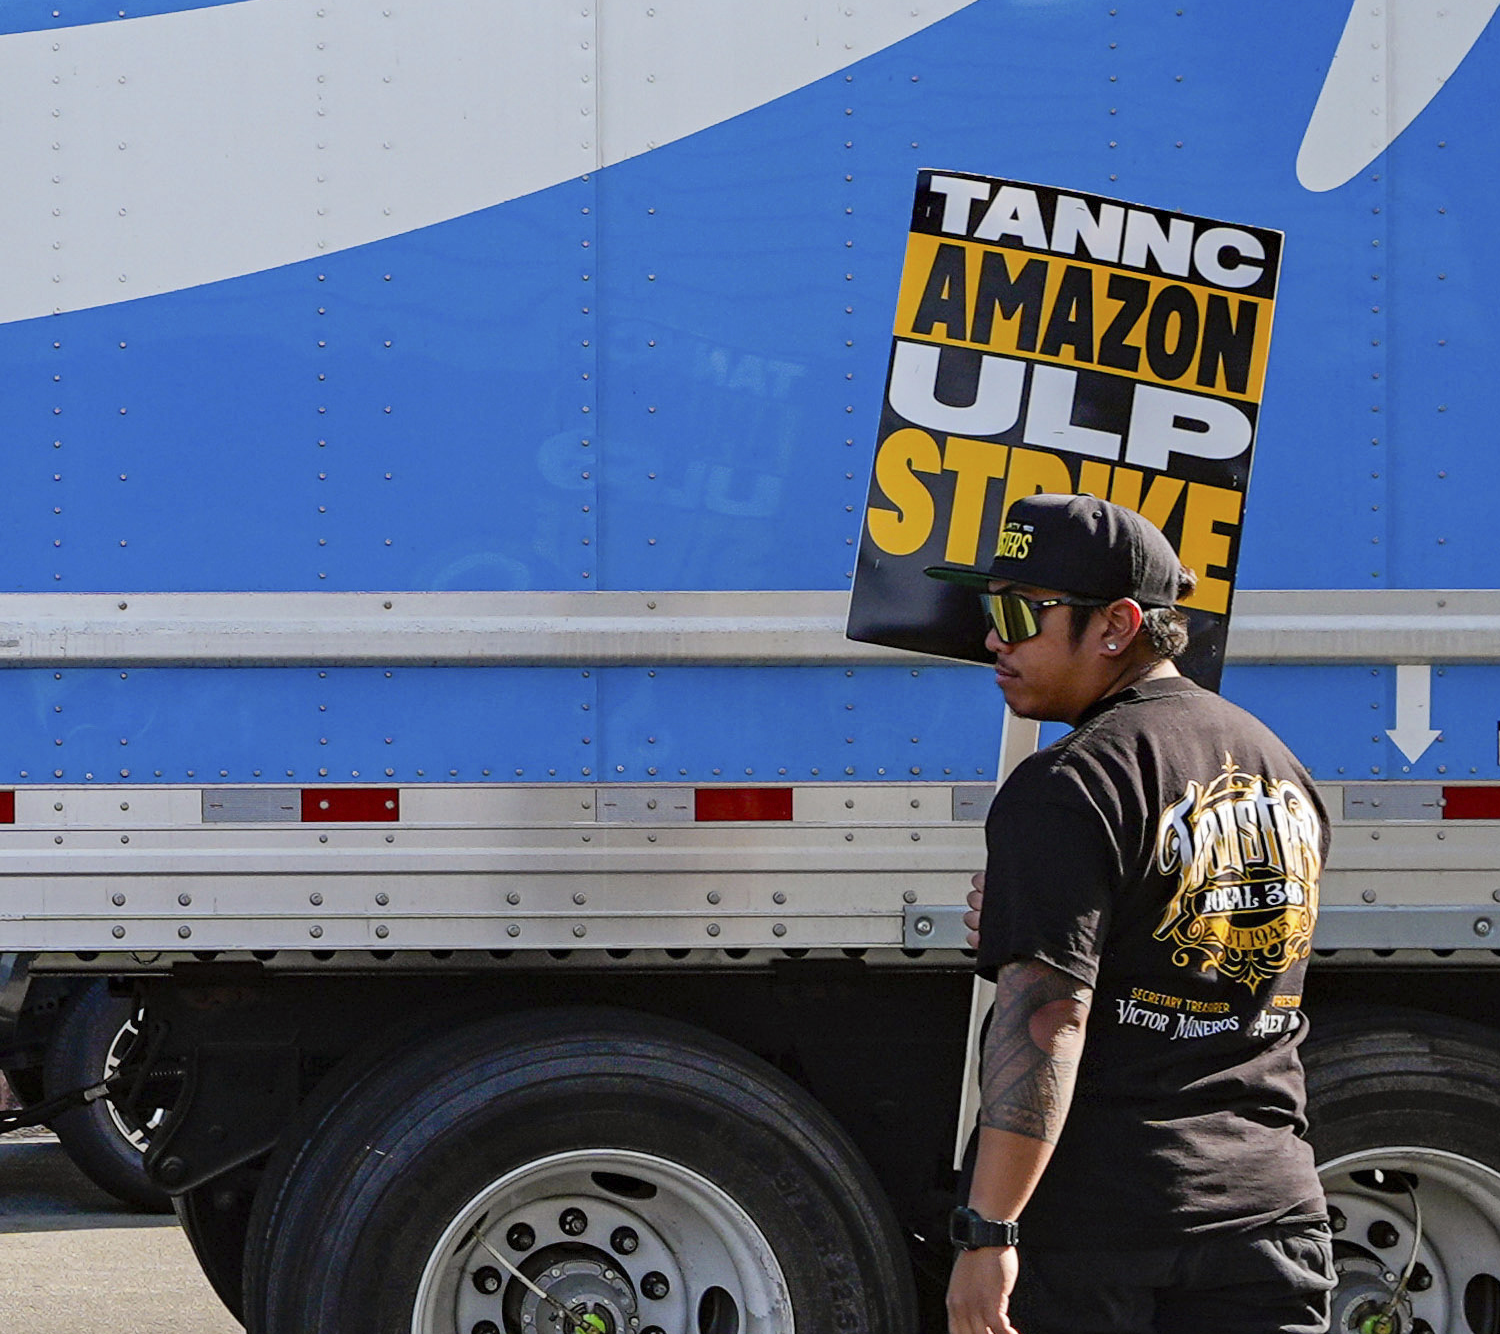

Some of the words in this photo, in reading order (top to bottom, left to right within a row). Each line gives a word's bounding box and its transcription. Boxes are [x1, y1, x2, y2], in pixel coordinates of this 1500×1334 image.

[929, 174, 1266, 288] TANNC
[911, 242, 1259, 395] AMAZON
[888, 339, 1253, 471] ULP
[1222, 926, 1244, 948] ST.
[1249, 917, 1291, 947] 1945
[1115, 998, 1170, 1033] VICTOR
[1170, 1012, 1240, 1041] MINEROS
[1131, 987, 1183, 1010] SECRETARY
[1252, 1010, 1286, 1039] ALEX
